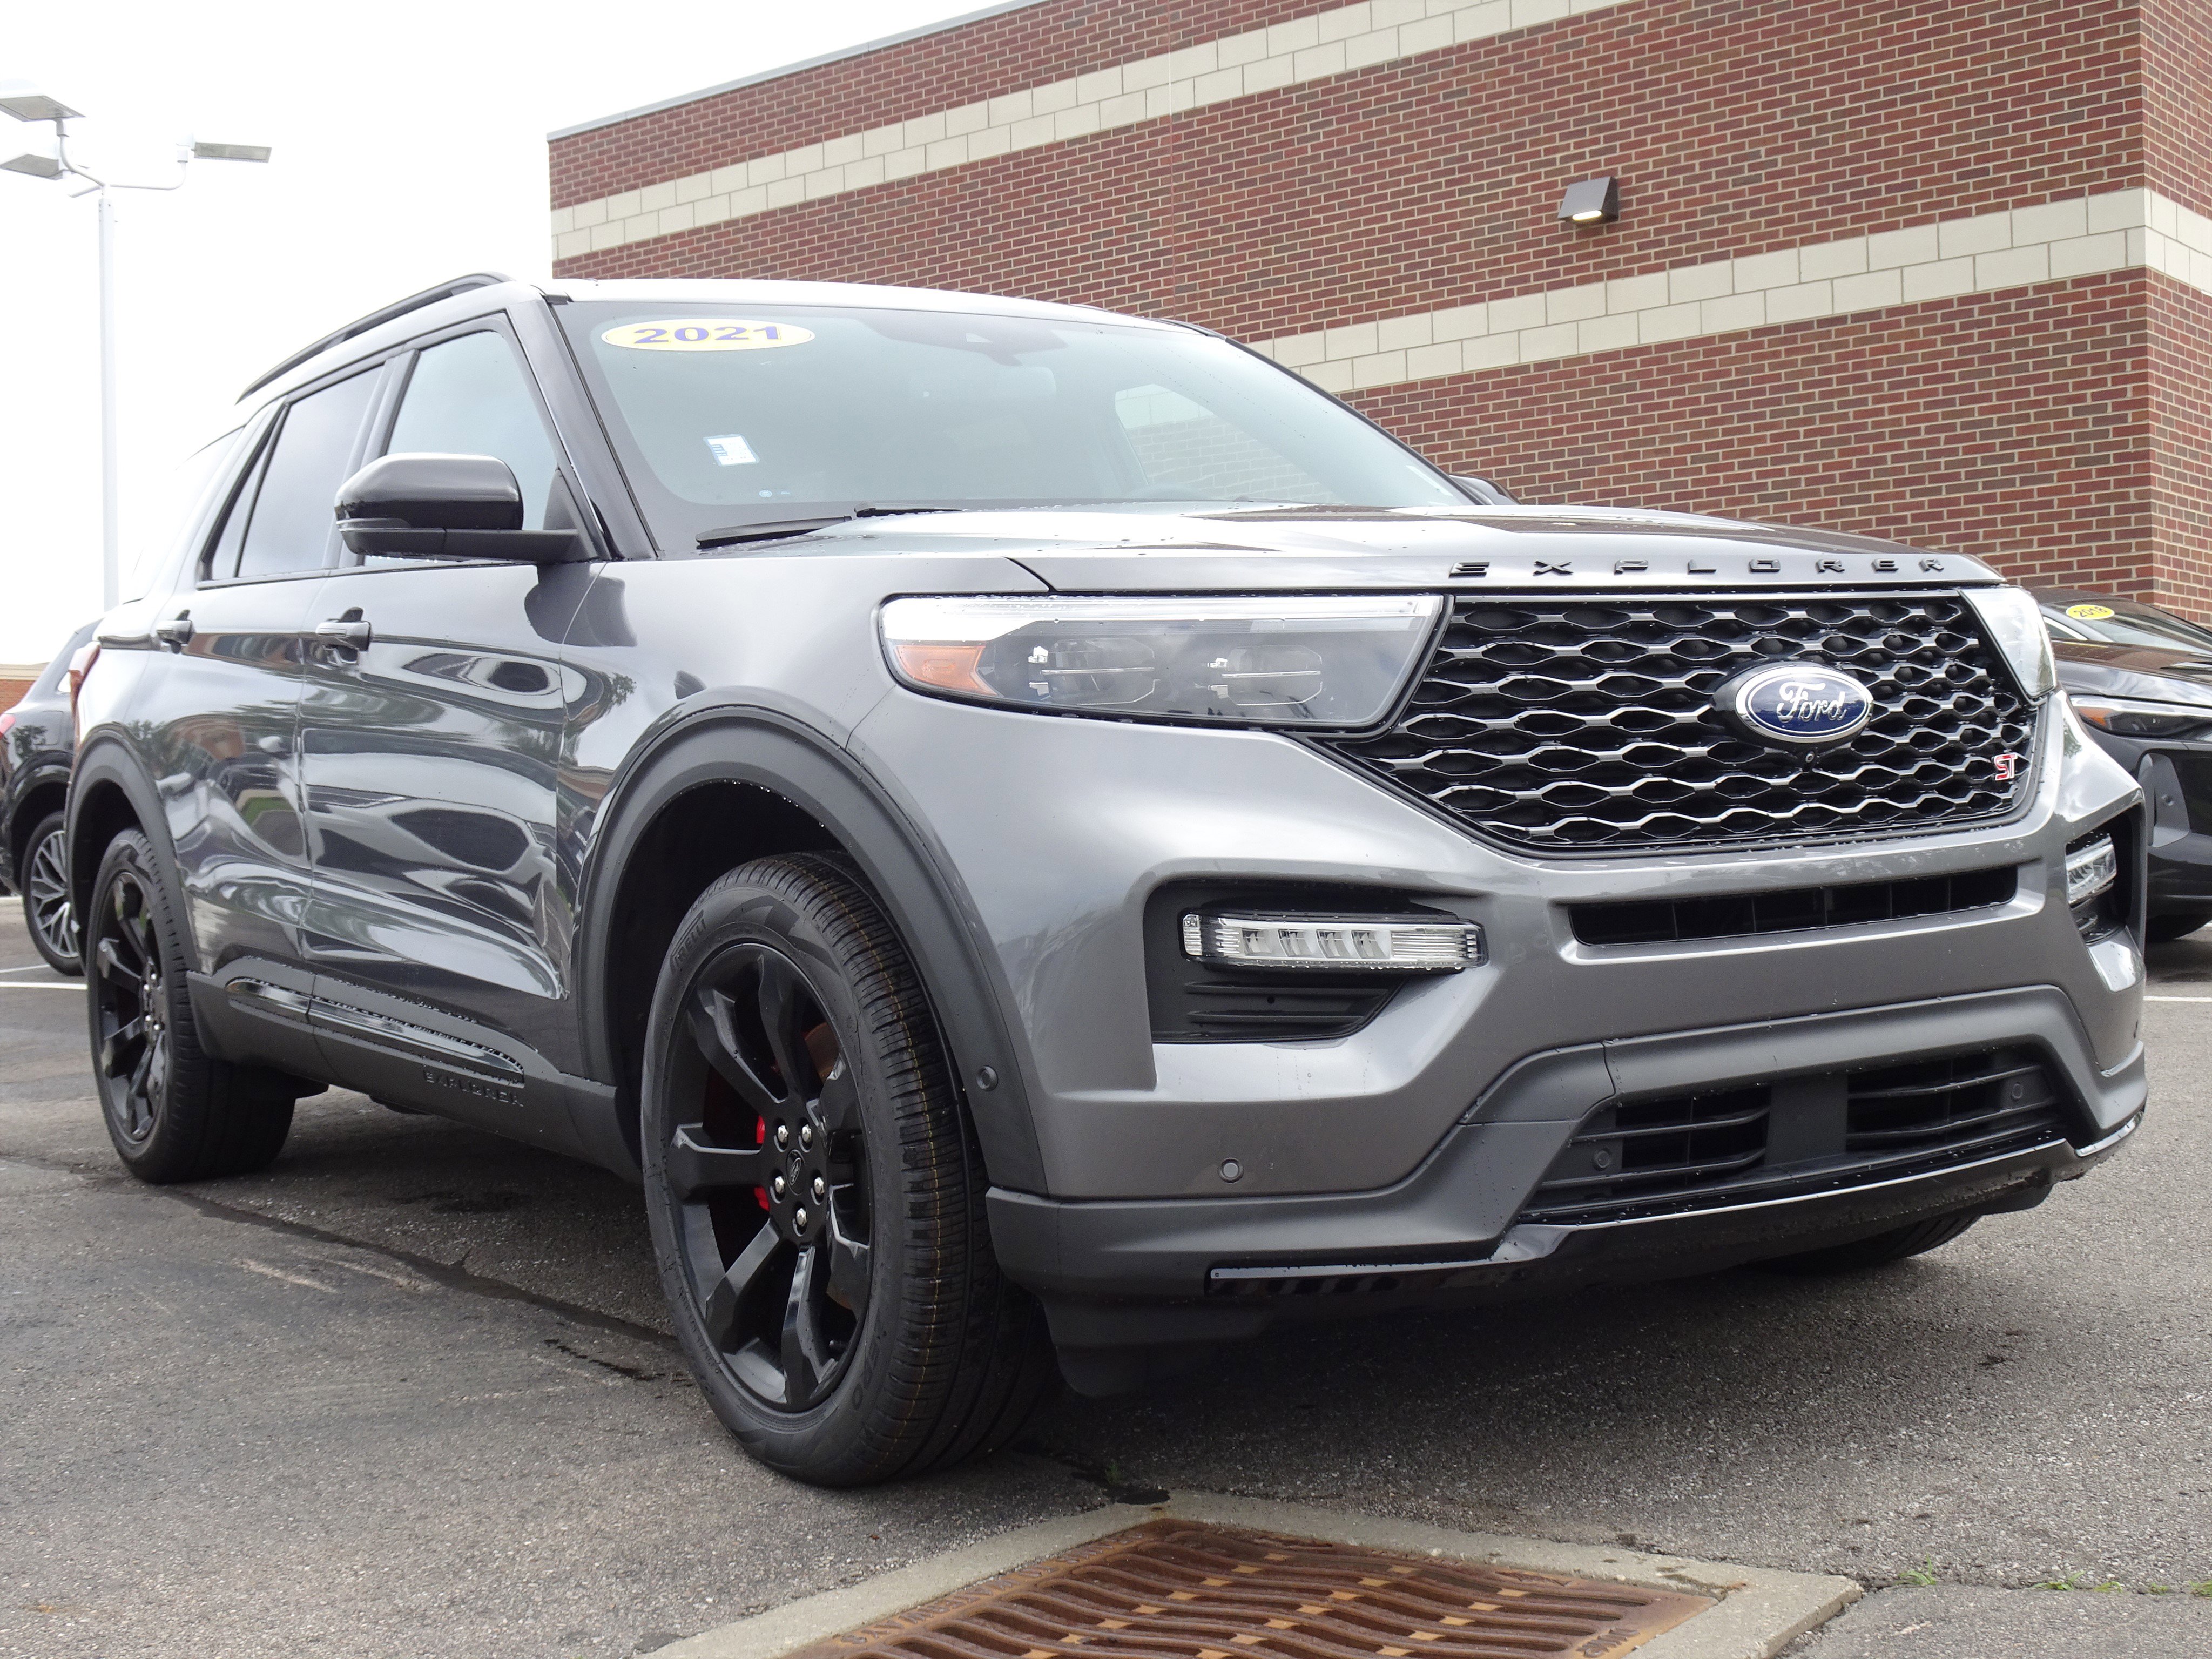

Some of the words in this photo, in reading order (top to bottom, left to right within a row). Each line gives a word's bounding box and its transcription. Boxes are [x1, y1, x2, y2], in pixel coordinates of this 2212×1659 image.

[633, 326, 779, 344] 2021
[1448, 557, 1945, 578] EXPLORER
[2073, 606, 2108, 617] 2018
[1776, 682, 1847, 723] Ford
[1994, 752, 2018, 781] ST
